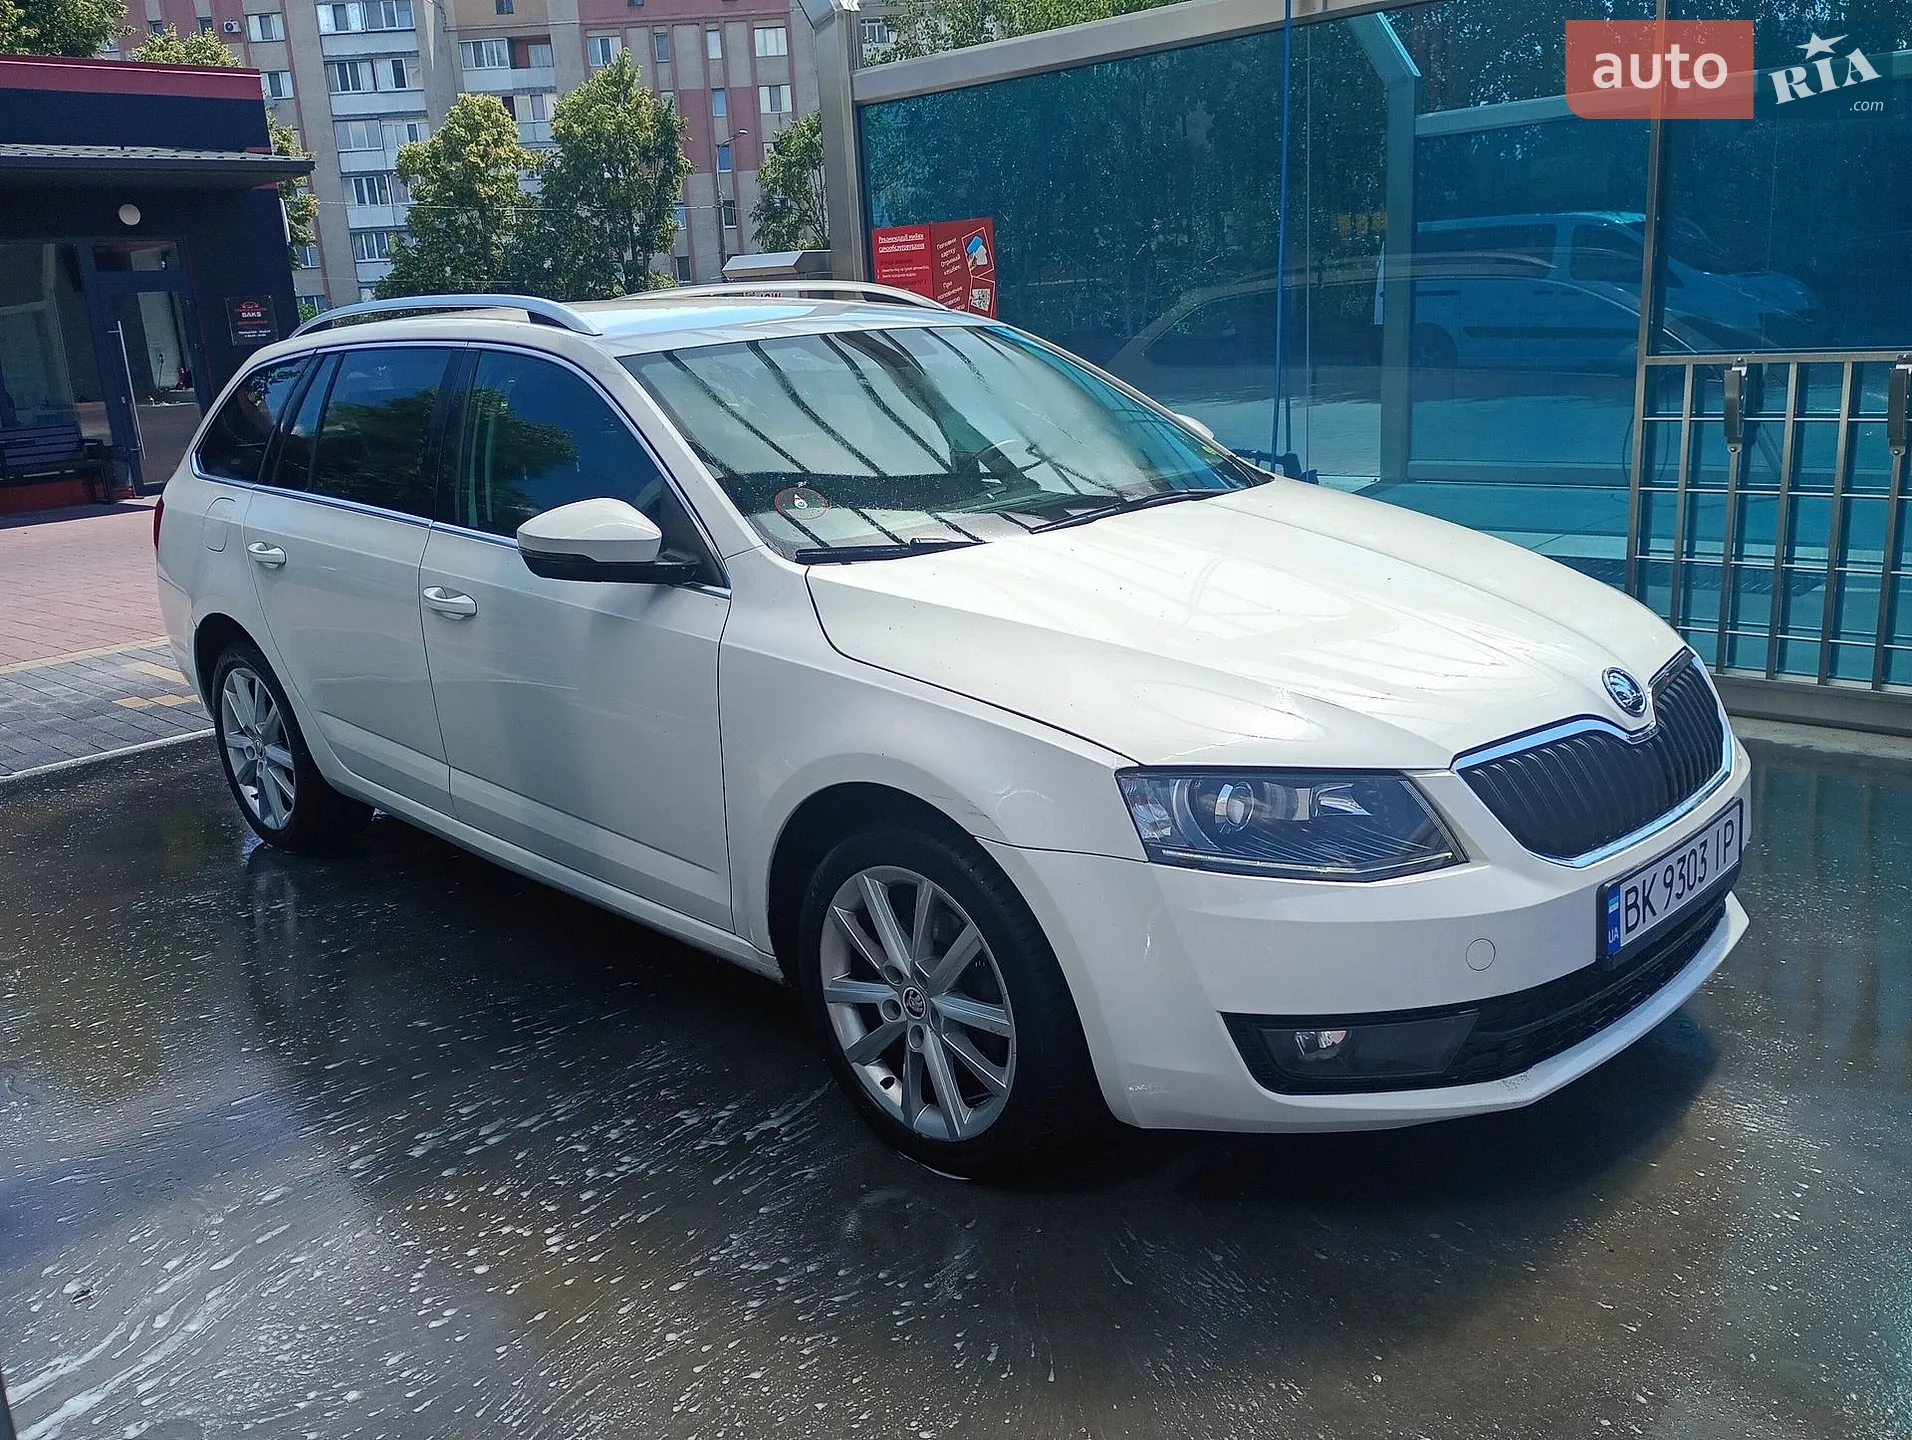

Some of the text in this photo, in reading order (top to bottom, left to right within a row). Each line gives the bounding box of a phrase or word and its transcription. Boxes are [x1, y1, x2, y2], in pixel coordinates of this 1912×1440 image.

[1624, 819, 1735, 935] BK 9303 IP
[1608, 926, 1620, 944] UA
